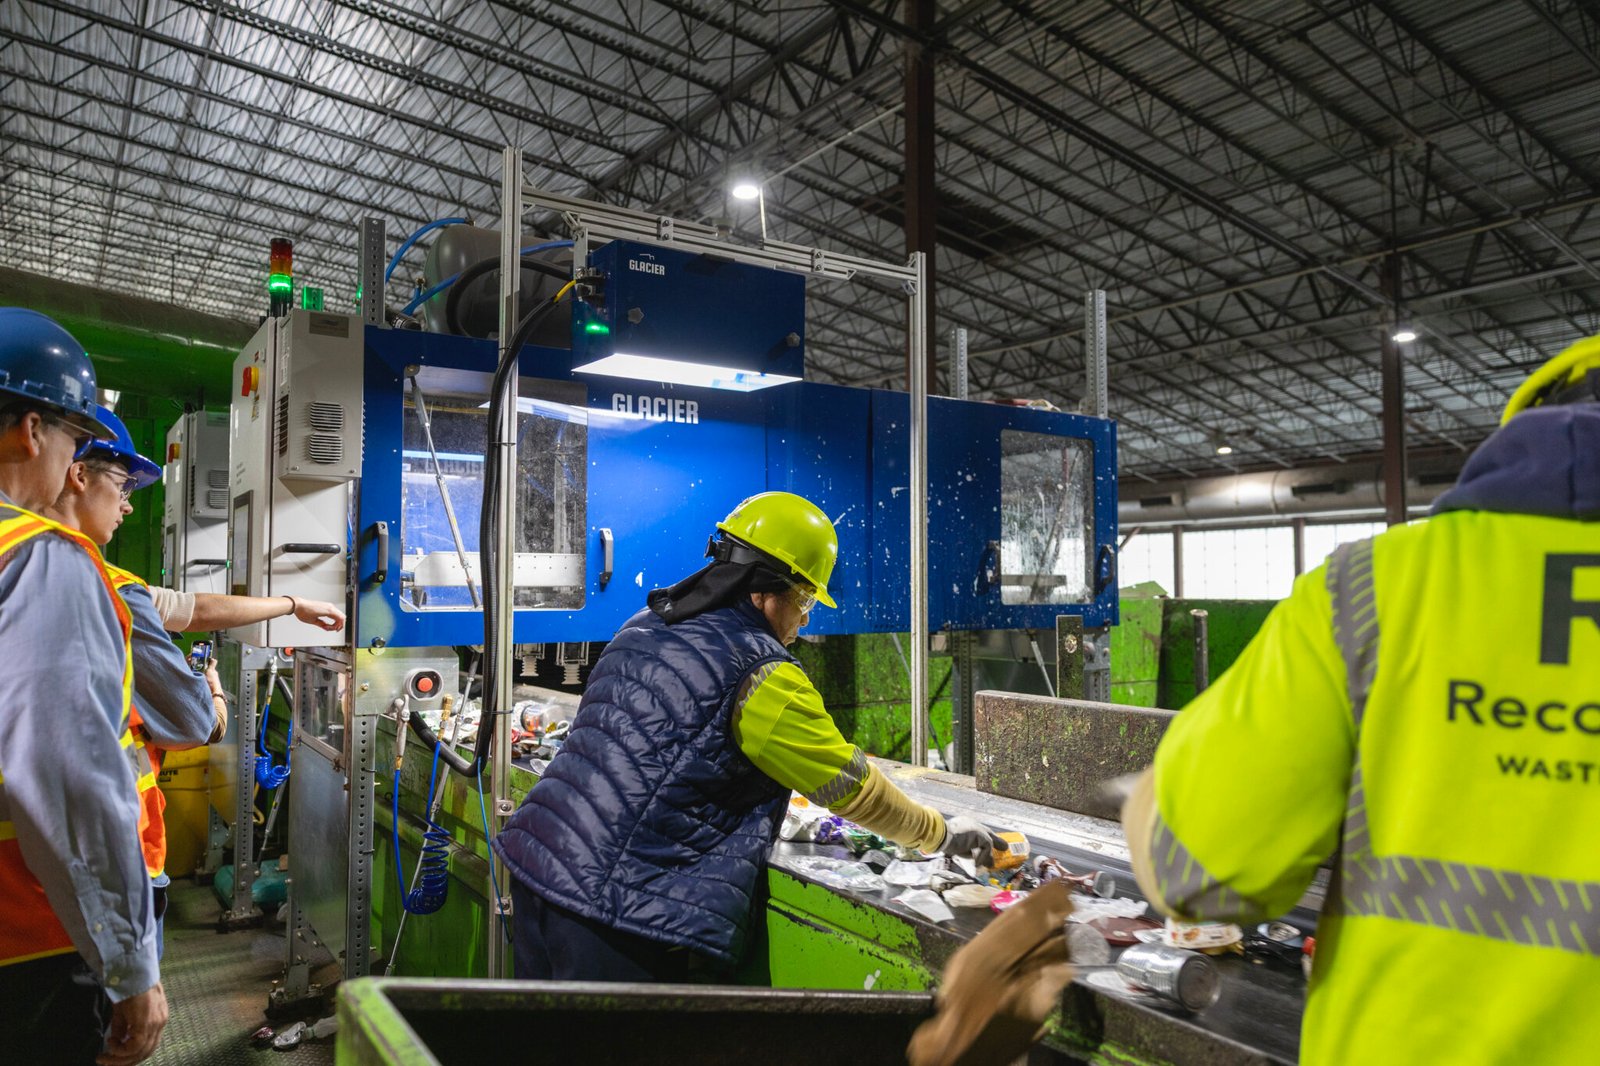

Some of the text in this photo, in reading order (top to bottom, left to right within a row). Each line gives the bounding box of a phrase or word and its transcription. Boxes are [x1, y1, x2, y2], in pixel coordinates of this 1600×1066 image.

[629, 259, 665, 276] GLACIER
[612, 393, 699, 425] GLACIER
[1447, 679, 1600, 736] Reco
[1496, 754, 1600, 784] WAST
